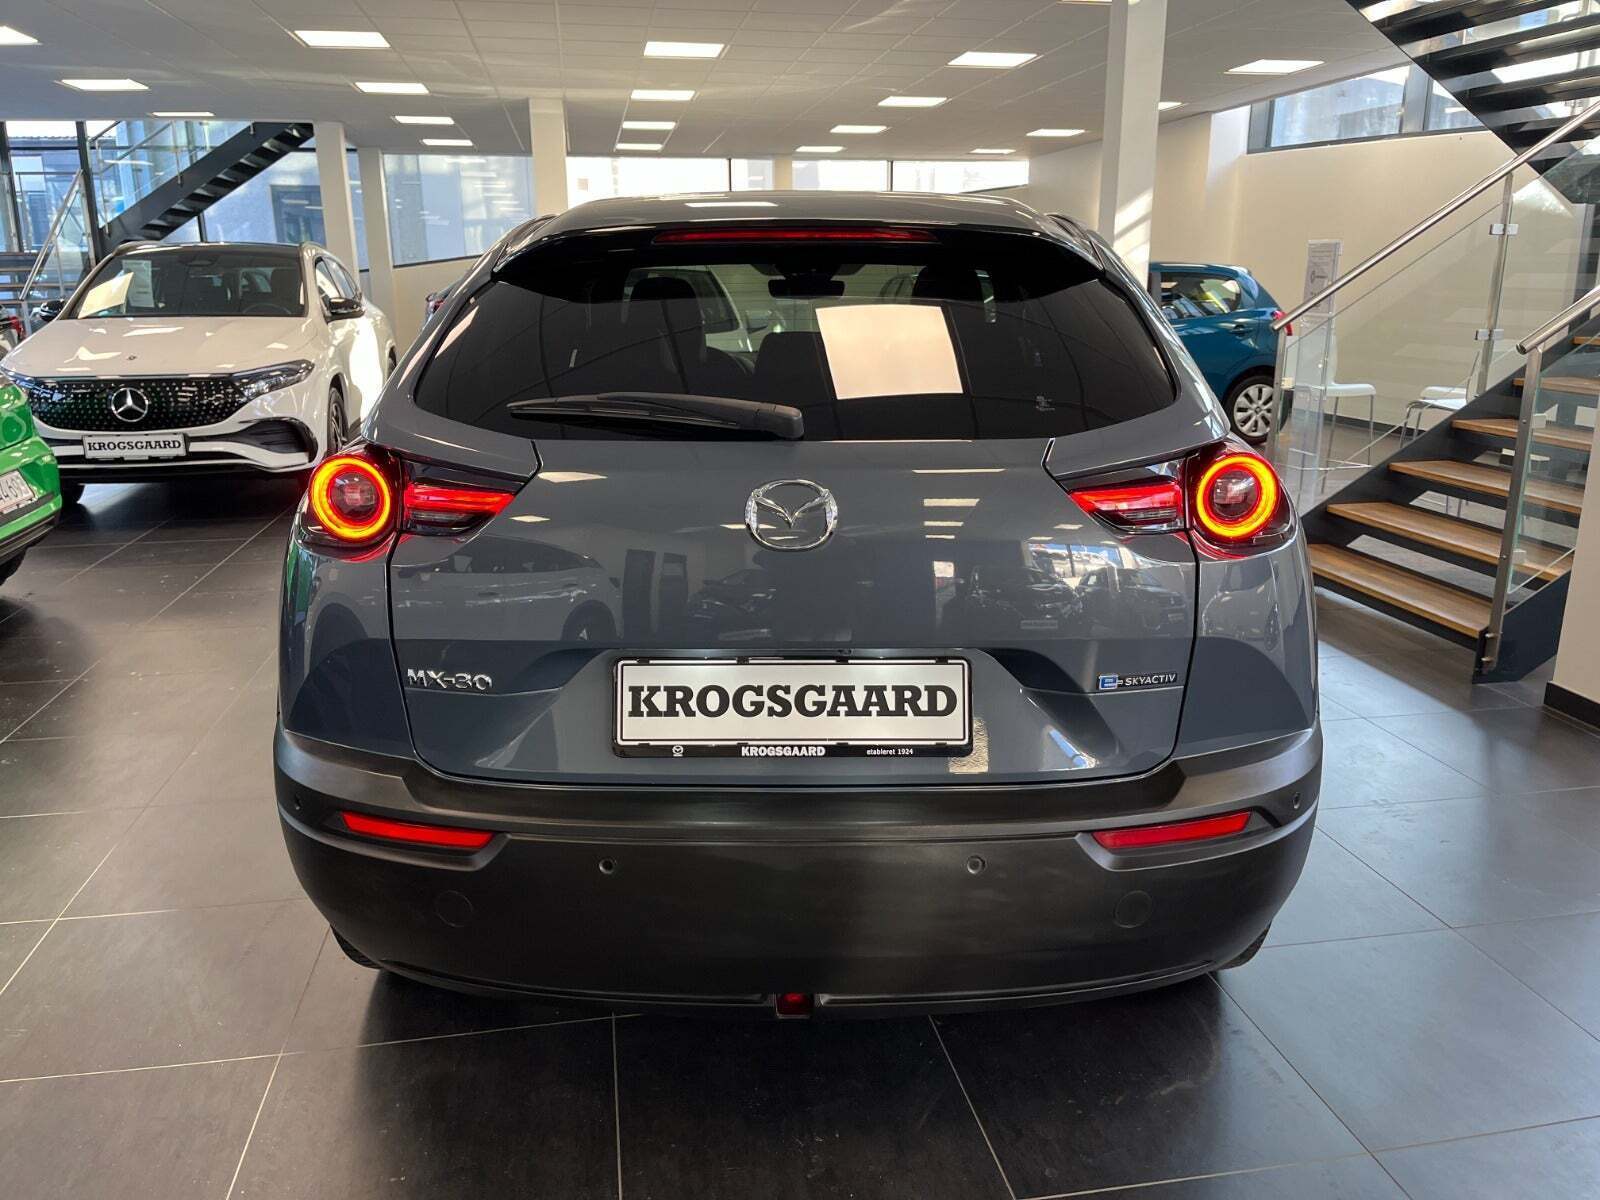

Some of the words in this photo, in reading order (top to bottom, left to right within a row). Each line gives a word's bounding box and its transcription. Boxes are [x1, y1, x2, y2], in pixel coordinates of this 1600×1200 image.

[87, 440, 181, 451] KROGSGAARD
[407, 668, 493, 690] MX-30
[627, 684, 958, 718] KROGSGAARD
[741, 746, 826, 757] KROGSGAARD
